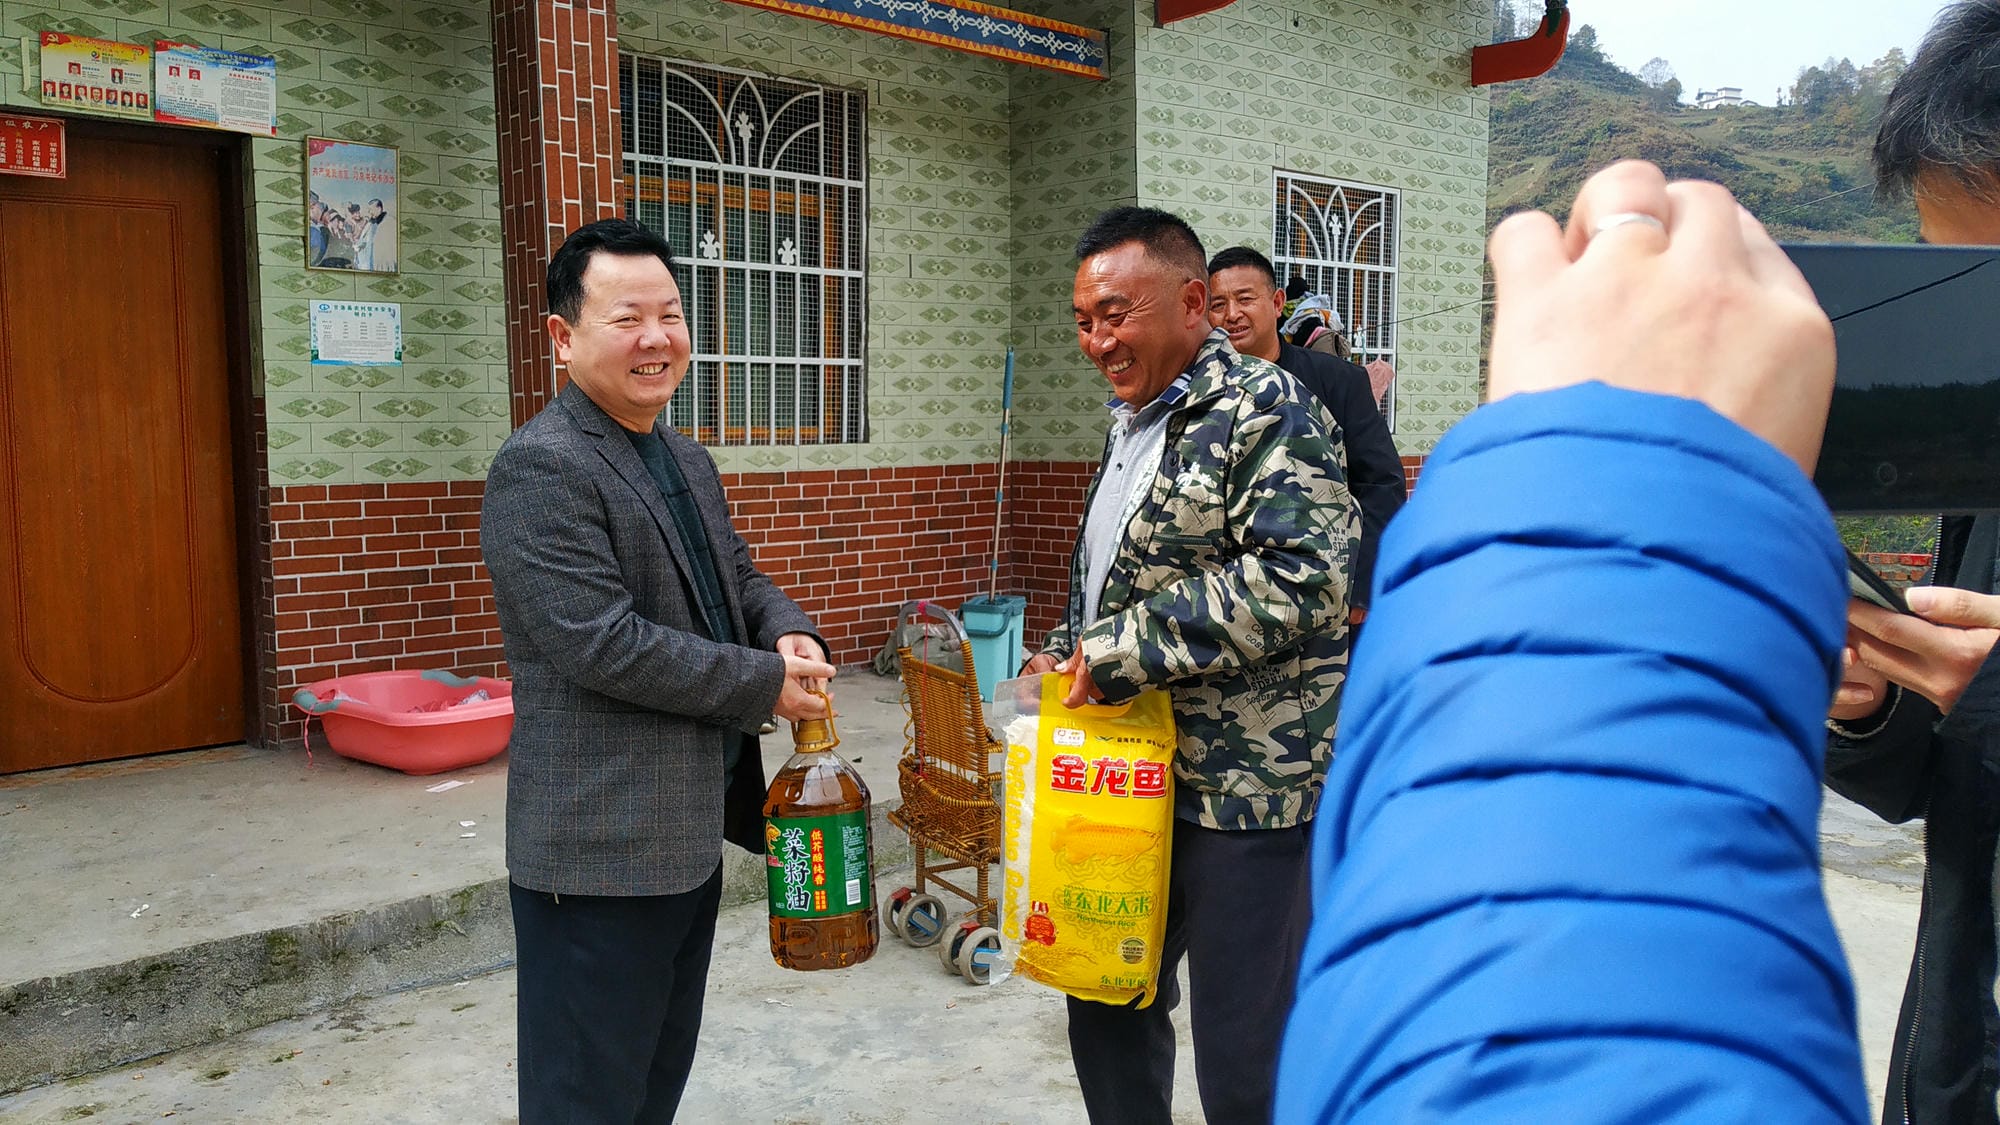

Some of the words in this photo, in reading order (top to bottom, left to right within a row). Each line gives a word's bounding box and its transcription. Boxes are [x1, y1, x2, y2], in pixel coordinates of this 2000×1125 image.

[1051, 754, 1166, 798] 金龙鱼
[782, 827, 811, 912] 菜籽油
[811, 830, 825, 885] 低芥酸纯香
[1076, 892, 1149, 914] 东北大米
[1076, 913, 1116, 926] Northeast
[1118, 919, 1137, 928] Rice
[1100, 975, 1148, 987] 东北平原
